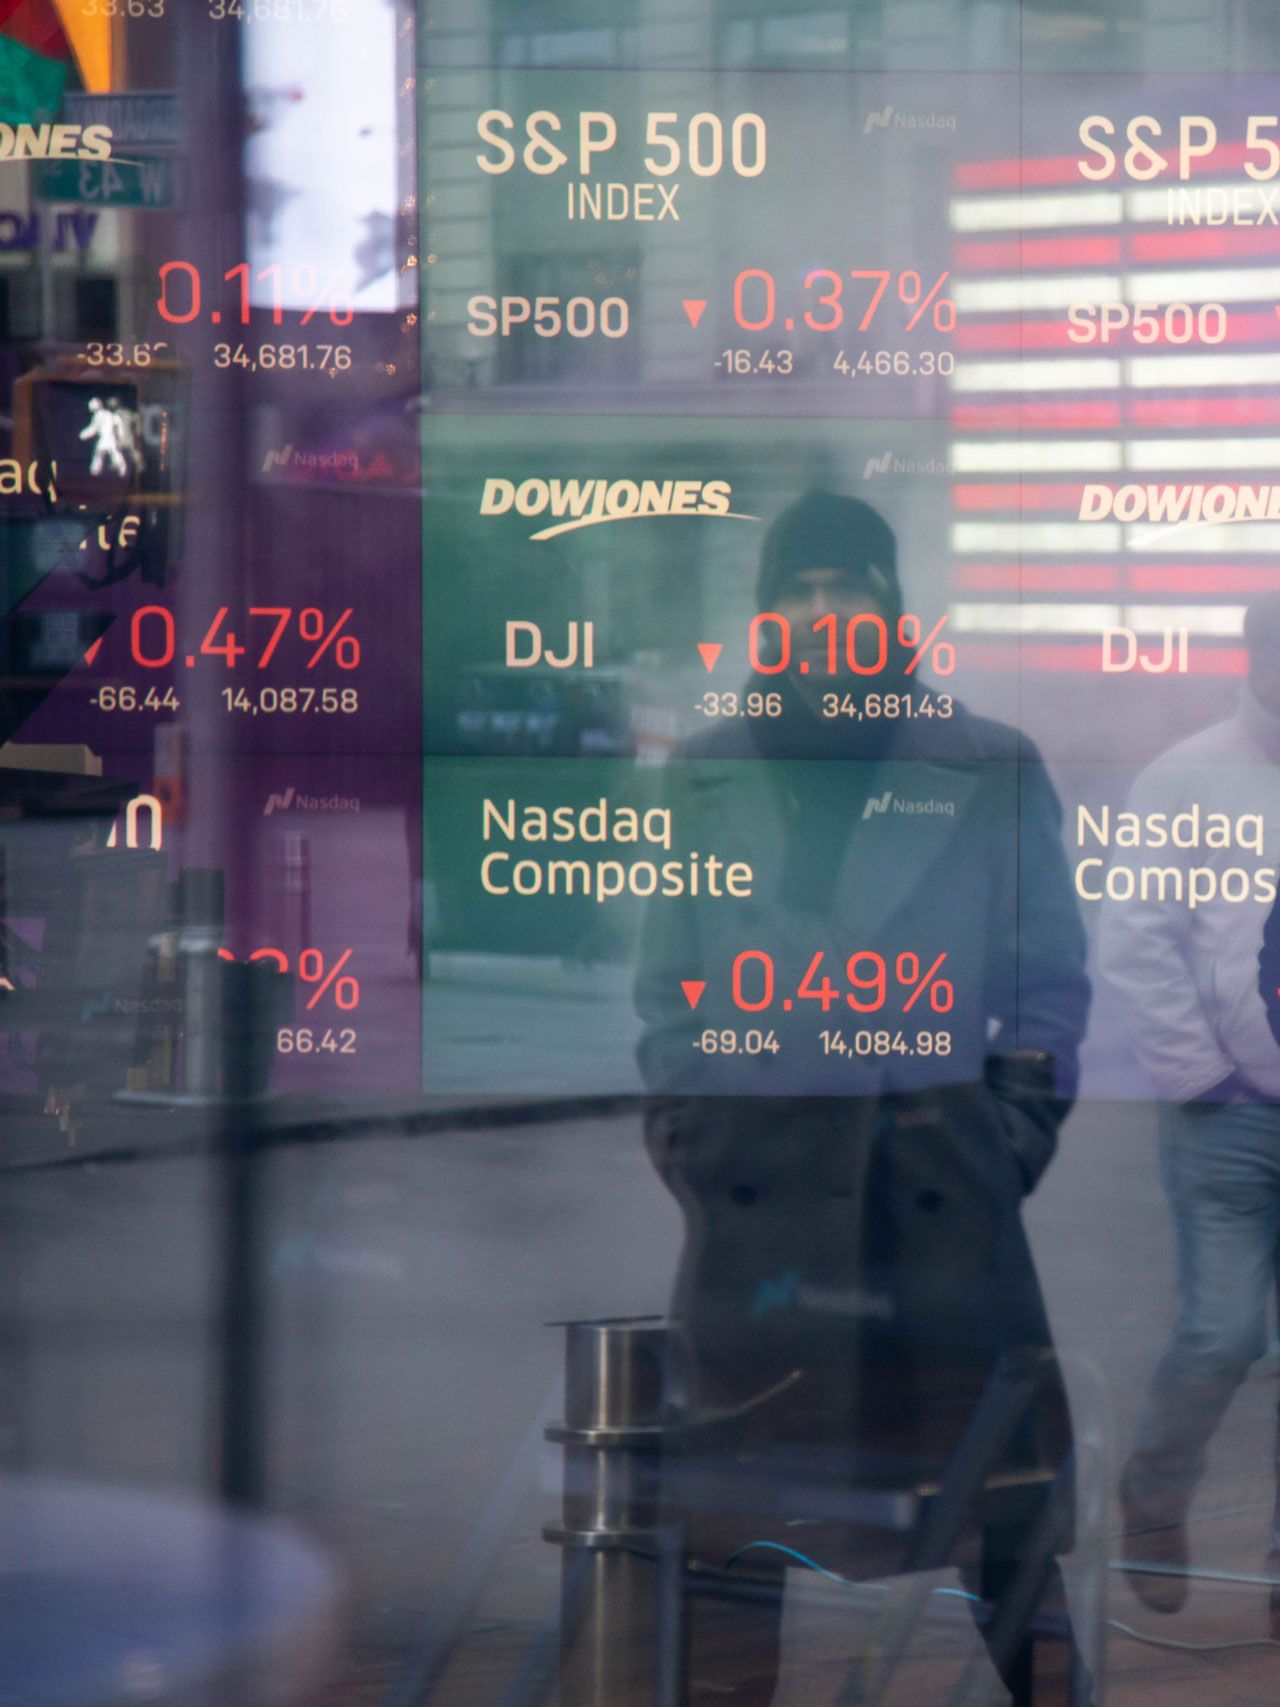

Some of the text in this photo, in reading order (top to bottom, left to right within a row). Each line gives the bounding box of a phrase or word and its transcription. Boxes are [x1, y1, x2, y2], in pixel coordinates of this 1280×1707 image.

[894, 112, 956, 131] Nasdaq
[476, 110, 766, 177] S&P 500
[1078, 115, 1217, 180] S&P
[568, 183, 680, 221] INDEX
[1167, 188, 1280, 226] INDEX
[156, 260, 354, 326] 0.11%
[733, 268, 956, 332] 0.37%
[467, 296, 629, 338] SP500
[1067, 302, 1227, 344] SP500
[77, 342, 352, 371] -33.6 34,681.76
[714, 349, 955, 378] -16.43 4,466.30
[294, 451, 359, 470] Nasdaq
[131, 605, 360, 669] 0.47%
[506, 621, 594, 668] DJI
[748, 612, 956, 676] 0.10%
[1102, 626, 1188, 673] DJI
[89, 686, 359, 715] -66.44 14,087.58
[694, 693, 954, 721] -33.96 34,681.43
[296, 795, 360, 812] Nasdaq
[482, 798, 673, 849] Nasdaq
[893, 798, 955, 817] Nasdaq
[1076, 803, 1265, 856] Nasdaq
[480, 852, 754, 902] Composite
[732, 949, 954, 1013] 0.49%
[693, 1030, 952, 1058] -69.04 14,084.98
